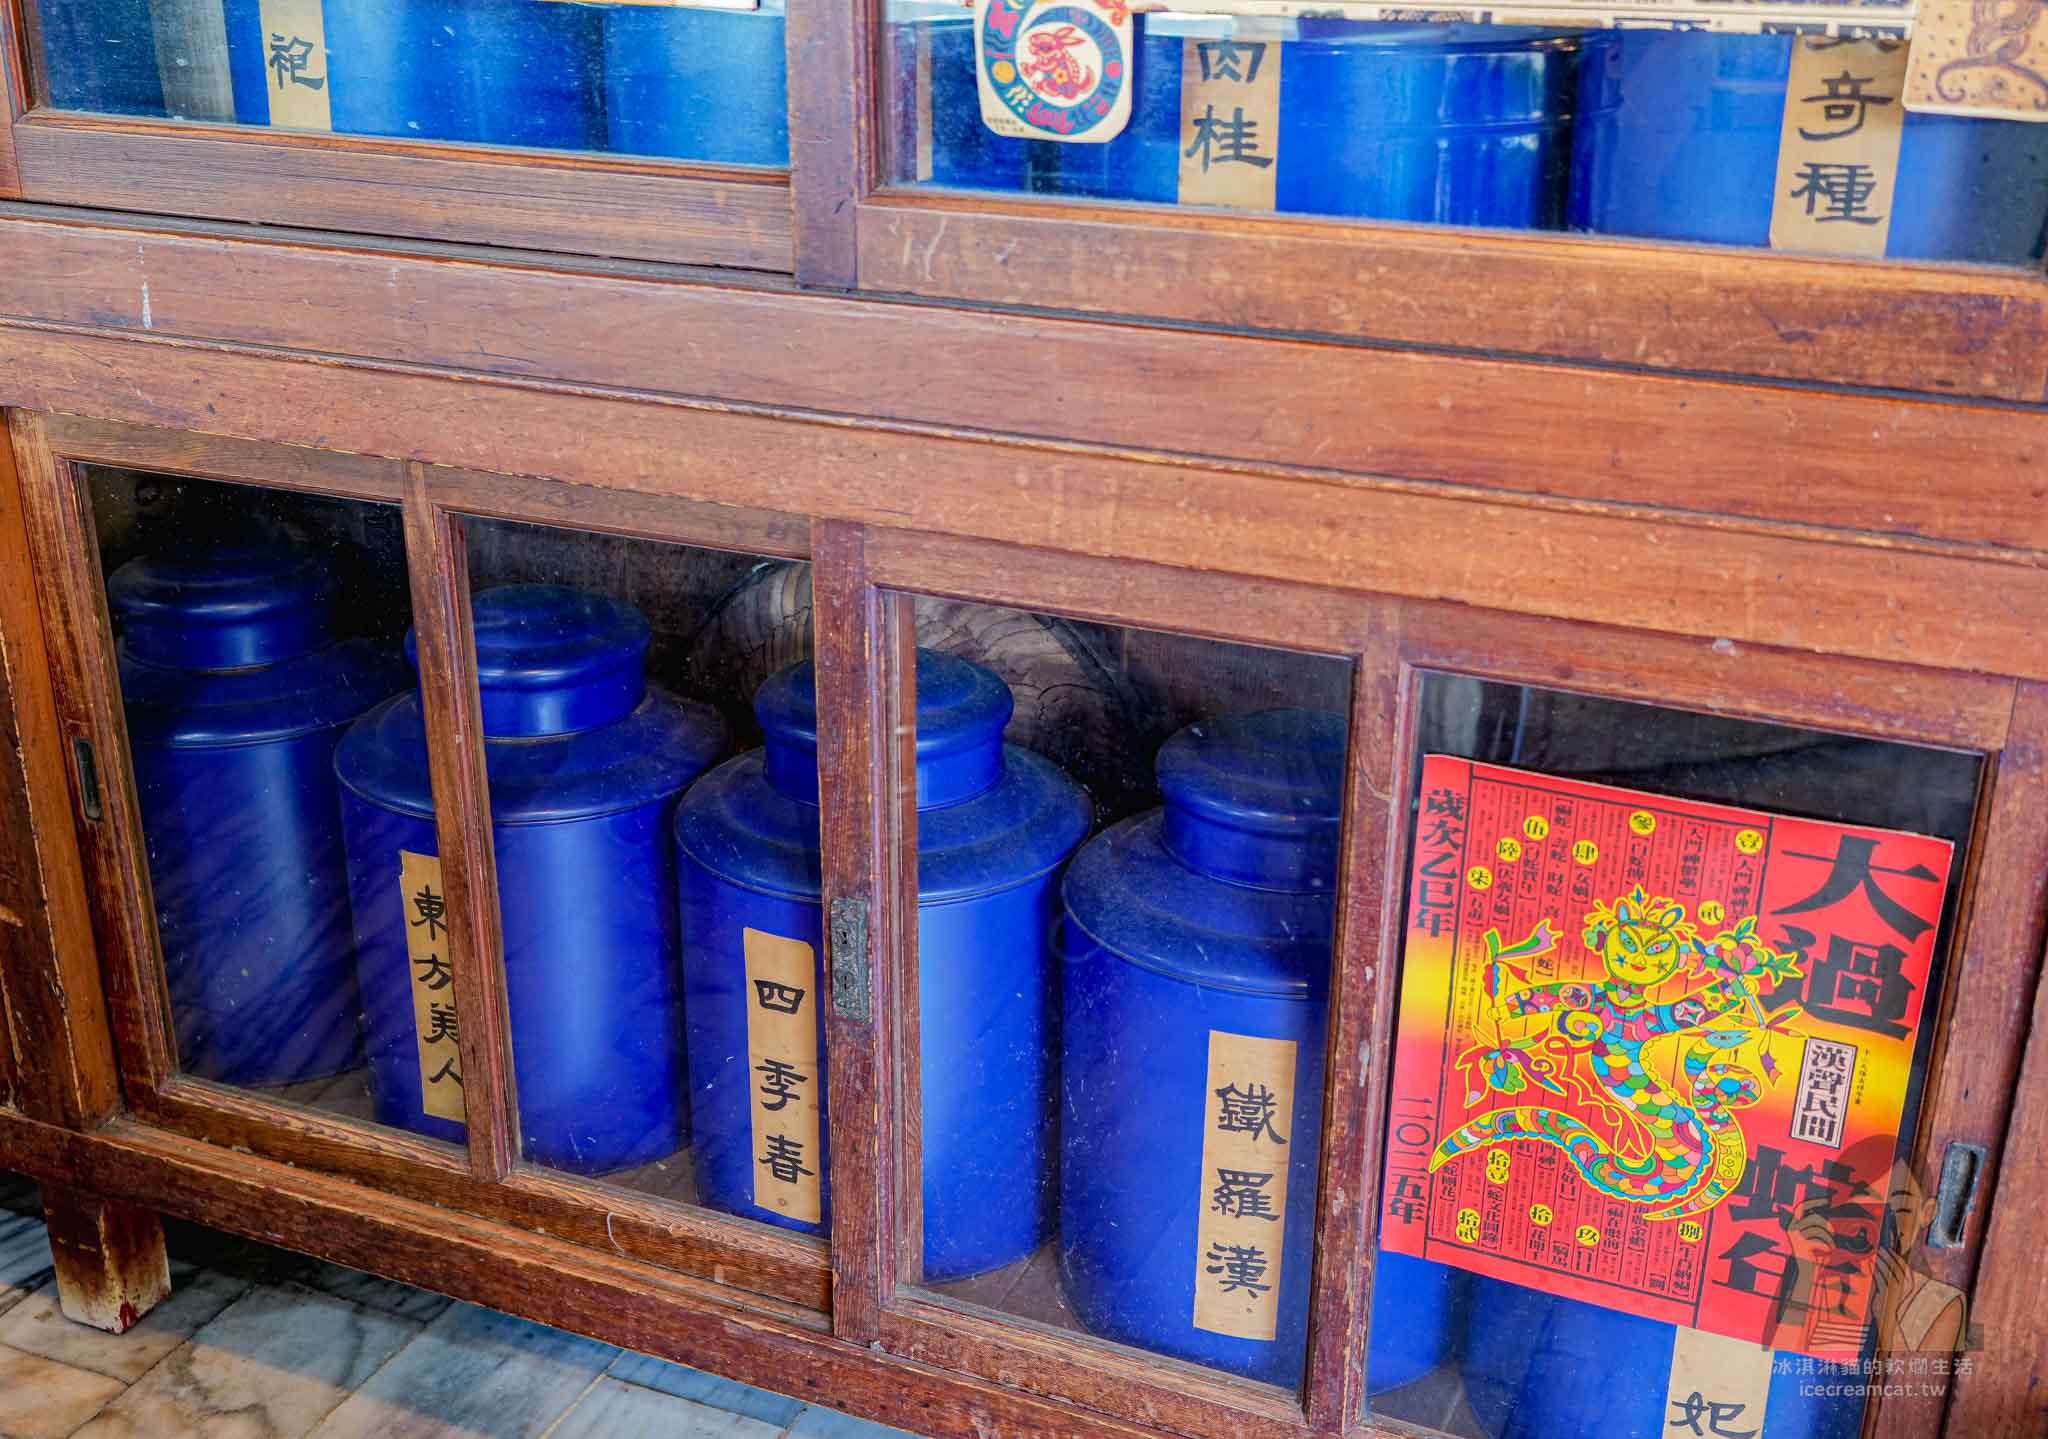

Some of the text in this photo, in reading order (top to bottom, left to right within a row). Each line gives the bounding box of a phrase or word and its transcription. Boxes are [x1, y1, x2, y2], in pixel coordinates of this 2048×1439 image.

[269, 32, 325, 91] 袍
[1186, 40, 1273, 175] 肉桂
[1790, 34, 1907, 226] 奇種
[410, 884, 464, 1088] 東方美人
[753, 979, 815, 1184] 四季春
[1206, 1082, 1288, 1298] 鐵羅漢
[1457, 1210, 1478, 1240] 拾貳
[1670, 1391, 1761, 1439] 妃
